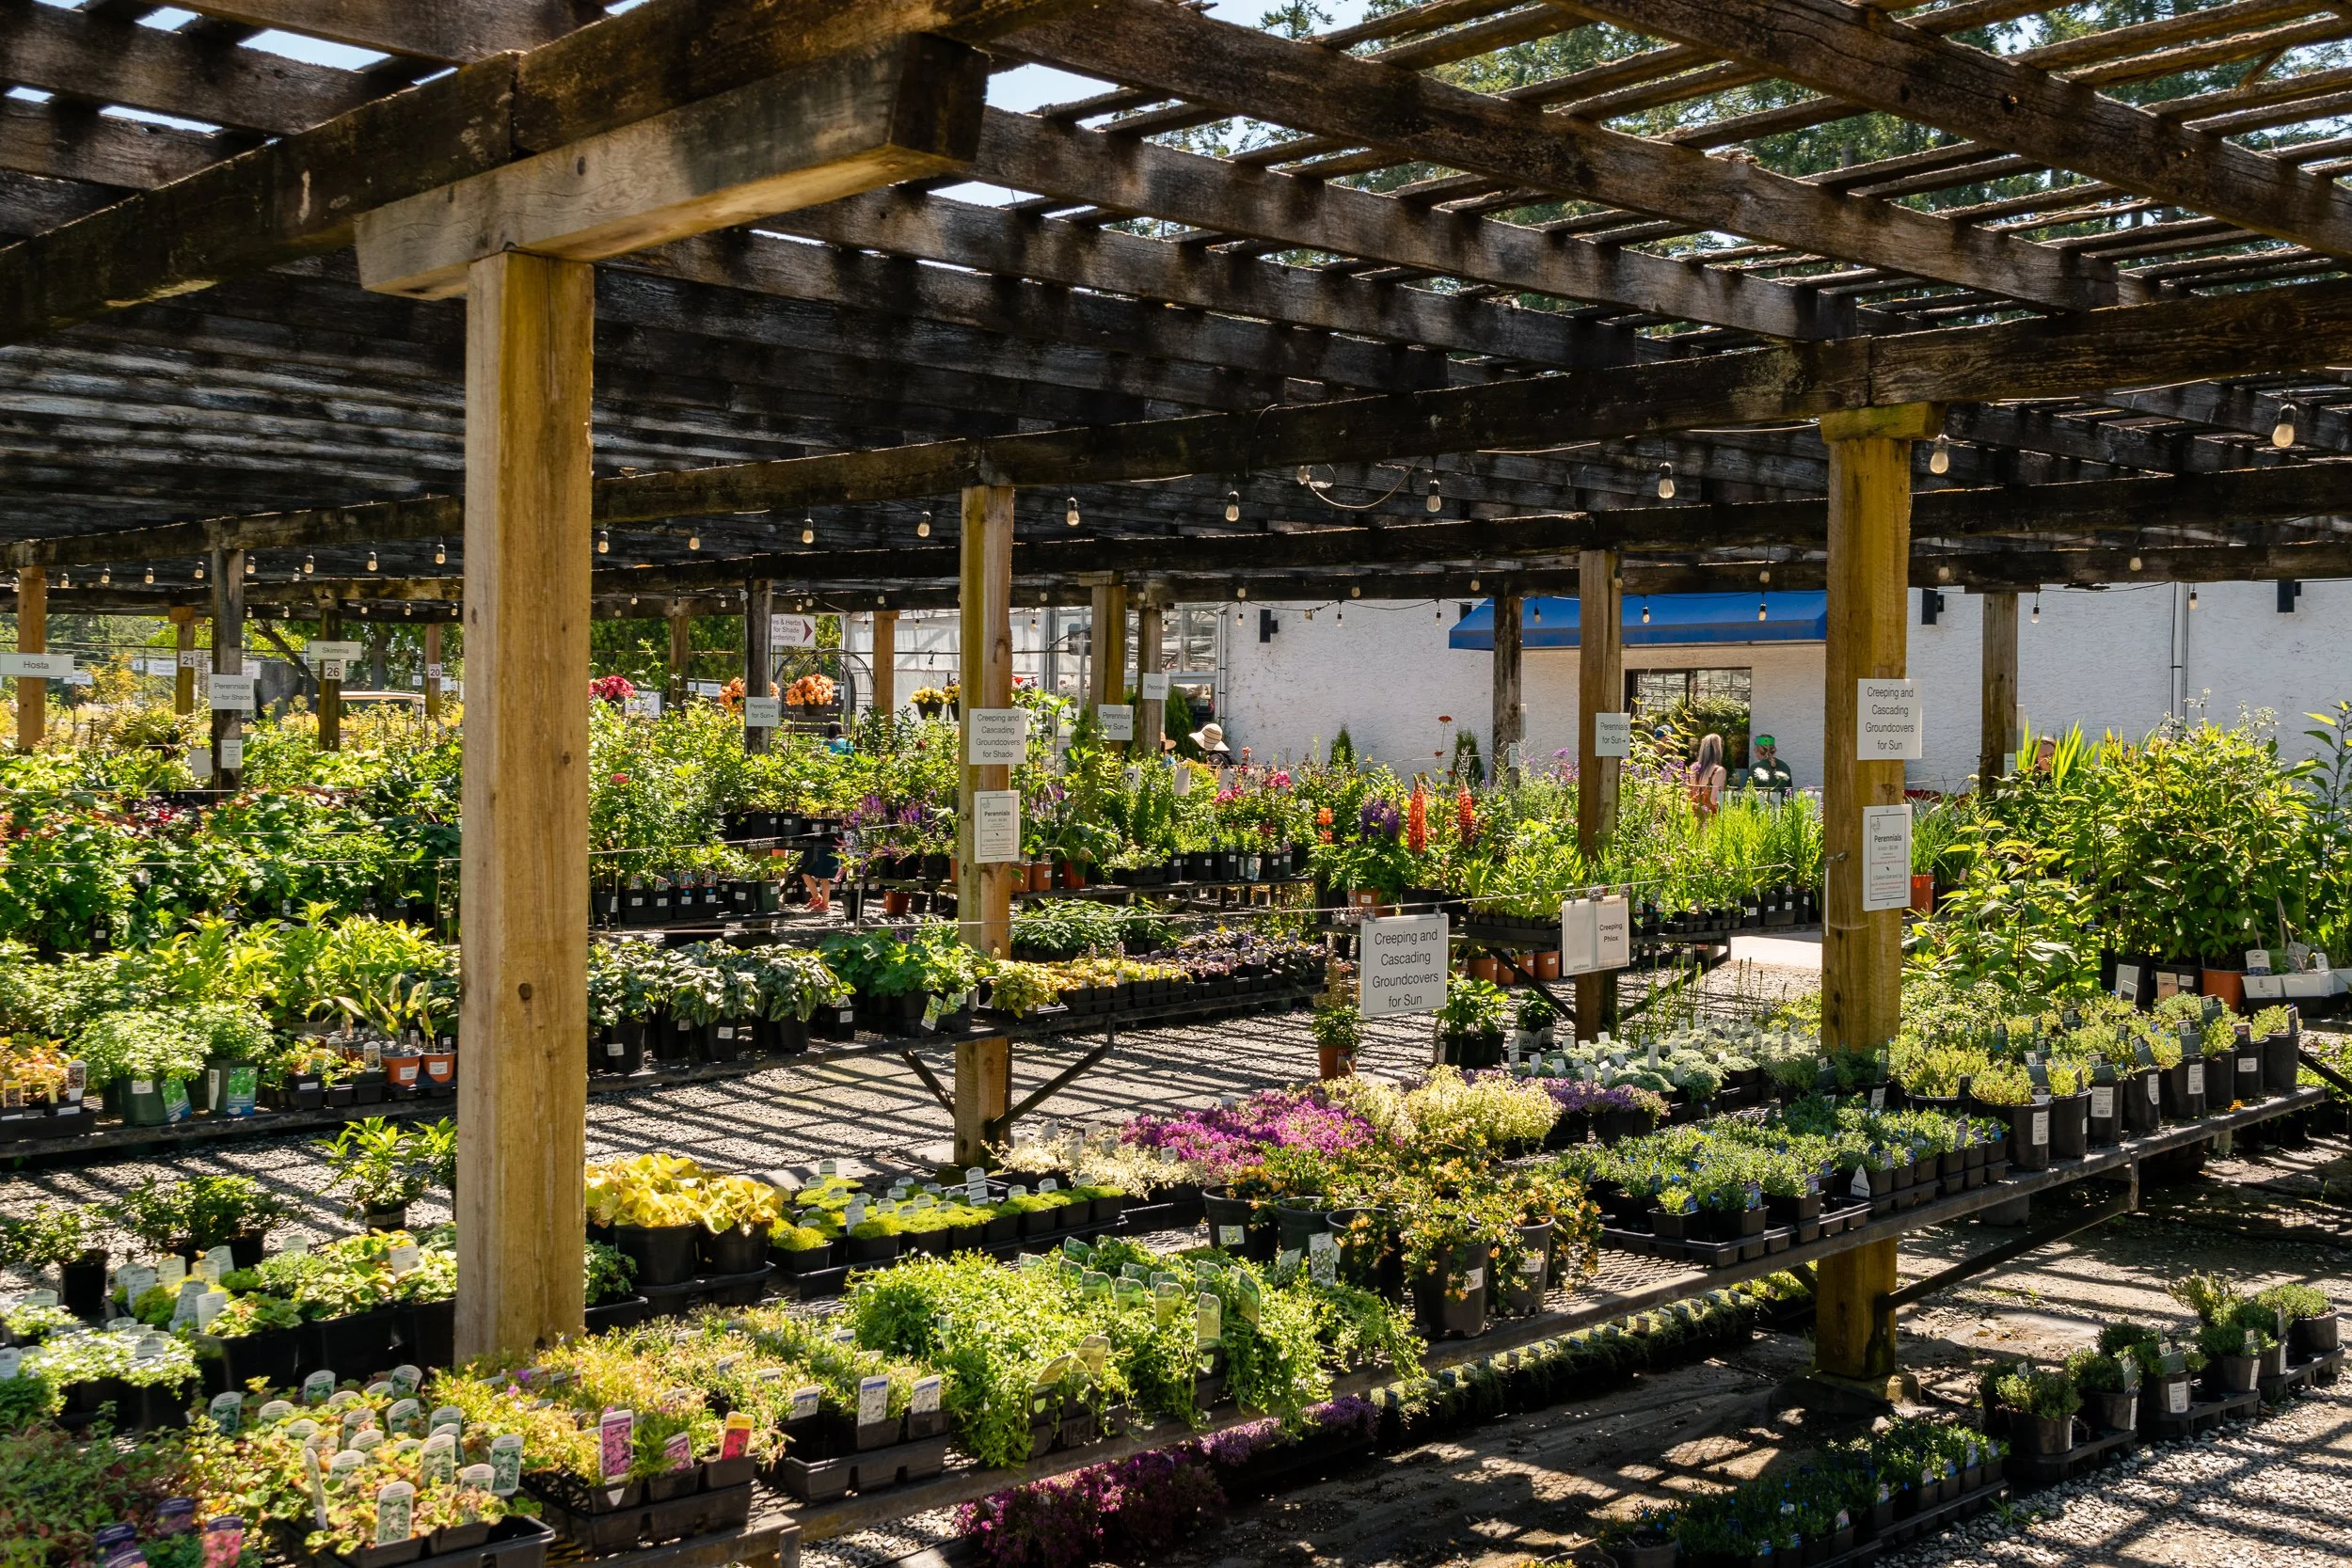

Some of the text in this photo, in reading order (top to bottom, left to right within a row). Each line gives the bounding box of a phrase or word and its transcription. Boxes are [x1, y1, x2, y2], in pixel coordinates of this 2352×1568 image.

[183, 657, 194, 665] 21
[326, 667, 340, 677] 26
[430, 668, 440, 676] 20
[1867, 686, 1914, 700] Creeping and
[1872, 705, 1909, 717] Cascading
[977, 714, 1006, 723] Creeping
[981, 726, 1015, 735] Cascading
[1600, 722, 1629, 731] Perennials
[1866, 721, 1915, 733] Groundcovers
[1611, 736, 1622, 744] Sun
[1877, 739, 1903, 750] for Sun
[993, 750, 1013, 758] Shade
[1874, 833, 1902, 842] Perennials
[1599, 923, 1623, 931] Creeping
[1375, 929, 1438, 945] Creeping and
[1380, 951, 1431, 966] Cascading
[1372, 973, 1438, 989] Groundcovers
[1389, 993, 1422, 1007] for Sun
